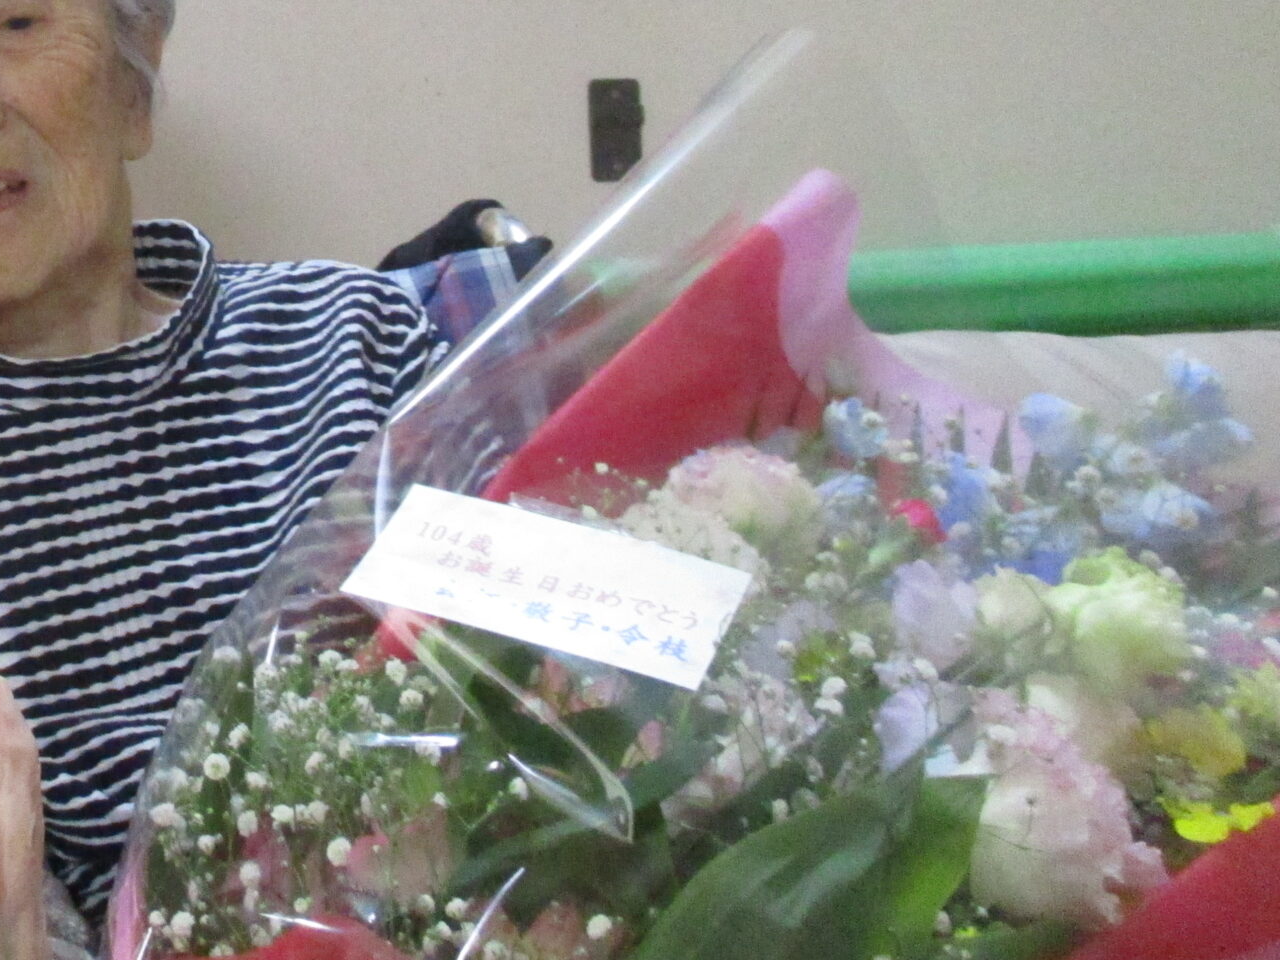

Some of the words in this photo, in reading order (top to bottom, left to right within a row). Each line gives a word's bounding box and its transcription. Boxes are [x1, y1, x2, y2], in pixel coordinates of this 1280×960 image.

[437, 549, 699, 632] お誕生日おめでとう
